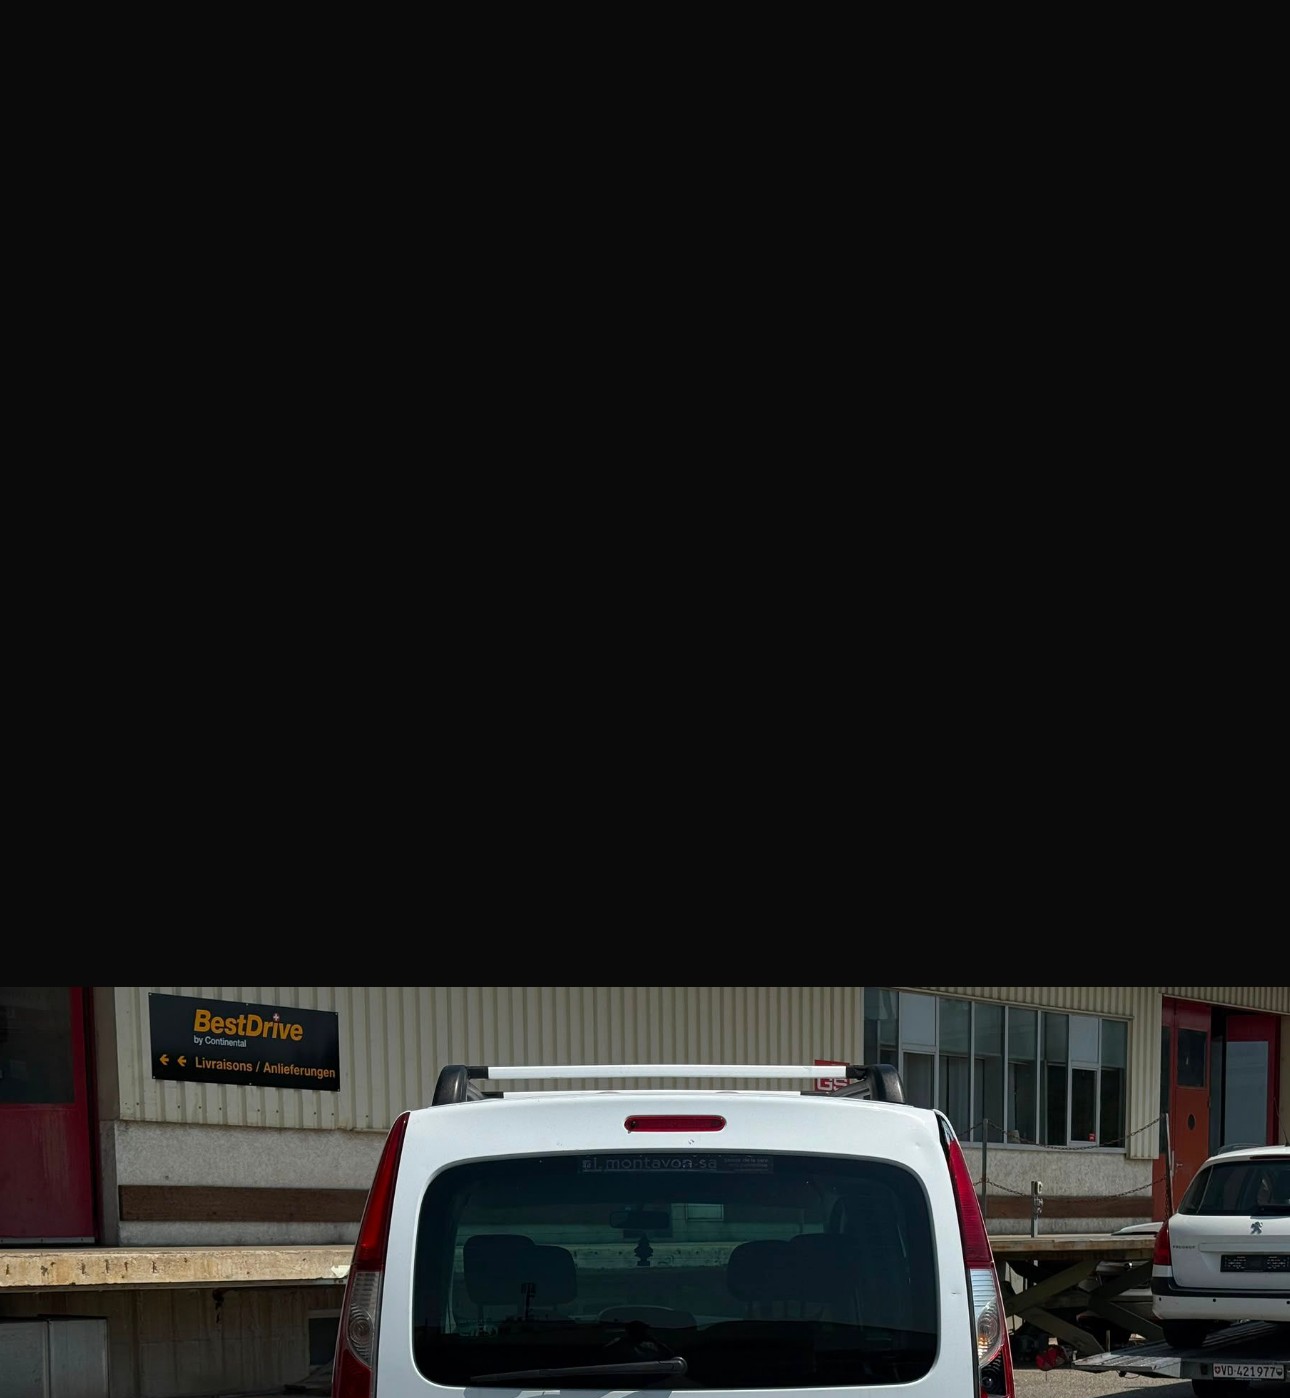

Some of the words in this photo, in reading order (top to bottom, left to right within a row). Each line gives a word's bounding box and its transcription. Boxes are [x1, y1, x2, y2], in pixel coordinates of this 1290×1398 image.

[193, 1009, 303, 1041] BestDrive
[193, 1035, 203, 1046] by
[205, 1035, 247, 1048] Continental
[195, 1056, 253, 1072] Livraisons
[255, 1061, 261, 1073] /
[263, 1061, 336, 1080] Anlieferungen
